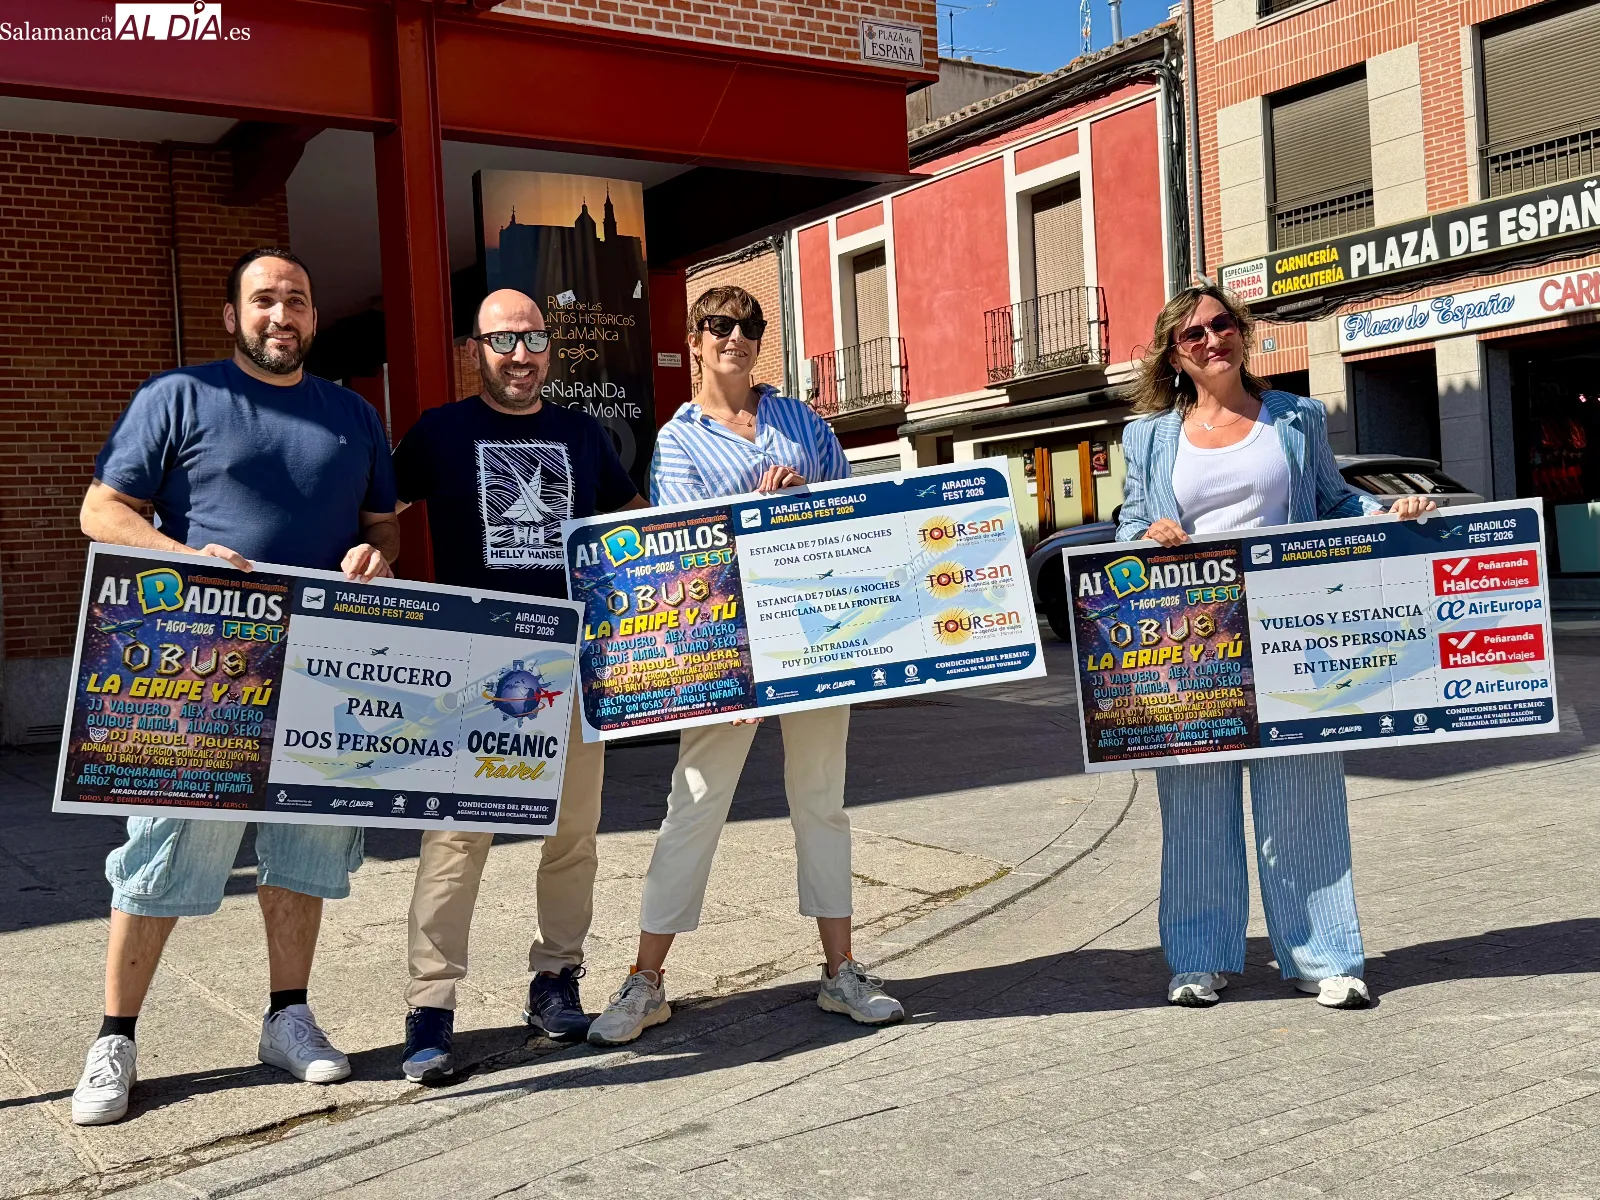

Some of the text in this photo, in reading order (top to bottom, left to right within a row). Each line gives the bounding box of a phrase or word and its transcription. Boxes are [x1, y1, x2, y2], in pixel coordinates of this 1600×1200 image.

[879, 30, 903, 42] PLAZA
[872, 43, 914, 60] ESPAÑA
[1351, 228, 1439, 278] PLAZA
[1449, 215, 1488, 257] DE
[1275, 245, 1339, 274] CARNICERÍA
[1225, 263, 1263, 277] ESPECIALIDAD
[1272, 264, 1344, 295] CHARCUTERÍA
[1227, 275, 1262, 290] TERNERA
[1232, 287, 1263, 300] ORDERO
[1344, 293, 1515, 340] Plaza de España
[1264, 340, 1273, 349] 10
[941, 477, 986, 491] AIRADILOS
[768, 493, 867, 515] TARJETA DE REGALO
[943, 488, 984, 501] FEST 2026
[770, 506, 854, 524] AIRADILOS FEST 2026
[1468, 519, 1517, 532] AIRADILOS
[750, 529, 892, 556] ESTANCIA DE 7 DÍAS 6 NOCHES
[1281, 533, 1386, 552] TARJETA DE REGALO
[1468, 531, 1514, 543] FEST 2026
[491, 550, 524, 558] HELLY
[680, 548, 734, 570] FEST
[773, 546, 872, 566] ZONA COSTA BLANCA
[1282, 545, 1372, 562] AIRADILOS FEST 2026
[1478, 558, 1528, 570] Peñaranda
[1443, 576, 1529, 592] Halcón viajes
[335, 591, 440, 612] TARJETA DE REGALO
[606, 578, 710, 615] OBUS
[757, 581, 900, 608] ESTANCIA DE 7 DÍAS 6 NOCHES
[1186, 584, 1241, 605] FEST
[333, 603, 424, 621] AIRADILOS FEST 2026
[760, 594, 901, 622] EN CHICLANA DE LA FRONTERA
[1468, 598, 1542, 615] AirEuropa
[516, 611, 559, 626] AIRADILOS
[584, 594, 738, 641] LA GRIPE Y TÚ
[1260, 604, 1423, 630] VUELOS Y ESTANCIA
[223, 620, 284, 643] FEST
[514, 623, 555, 636] FEST 2026
[1110, 613, 1216, 648] OBUS
[1484, 632, 1534, 644] Peñaranda
[804, 638, 868, 654] 2 ENTRADAS A
[1261, 628, 1427, 655] PARA DOS PERSONAS
[122, 640, 248, 678] OBUS
[782, 646, 893, 668] PUY DU FOU EN TOLEDO
[936, 657, 984, 669] CONDICIONES
[1000, 651, 1030, 660] PREMIO:
[1087, 633, 1243, 671] LA GRIPE Y TÚ
[1448, 649, 1535, 665] Halcón viajes
[307, 658, 452, 688] UN CRUCERO
[1294, 654, 1398, 675] EN TENERIFE
[86, 673, 272, 706] LA GRIPE Y TÚ
[1475, 678, 1549, 694] AirEuropa
[88, 698, 264, 722] JJ VAQUERO ÁLEX CLAVERO
[346, 697, 405, 719] PARA
[1446, 705, 1497, 715] CONDICIONES
[1452, 720, 1489, 728] PEÑARANDA
[1500, 716, 1541, 724] BRACAMONTE
[110, 732, 259, 750] DJ RAQUEL PIQUERAS
[284, 728, 454, 758] DOS PERSONAS
[467, 730, 558, 759] OCEANIC
[84, 764, 251, 782] ELECTROCHARANGA MOTOCICLONES
[474, 756, 547, 781] Travel
[458, 800, 506, 810] CONDICIONES
[521, 804, 549, 812] PREMIO:
